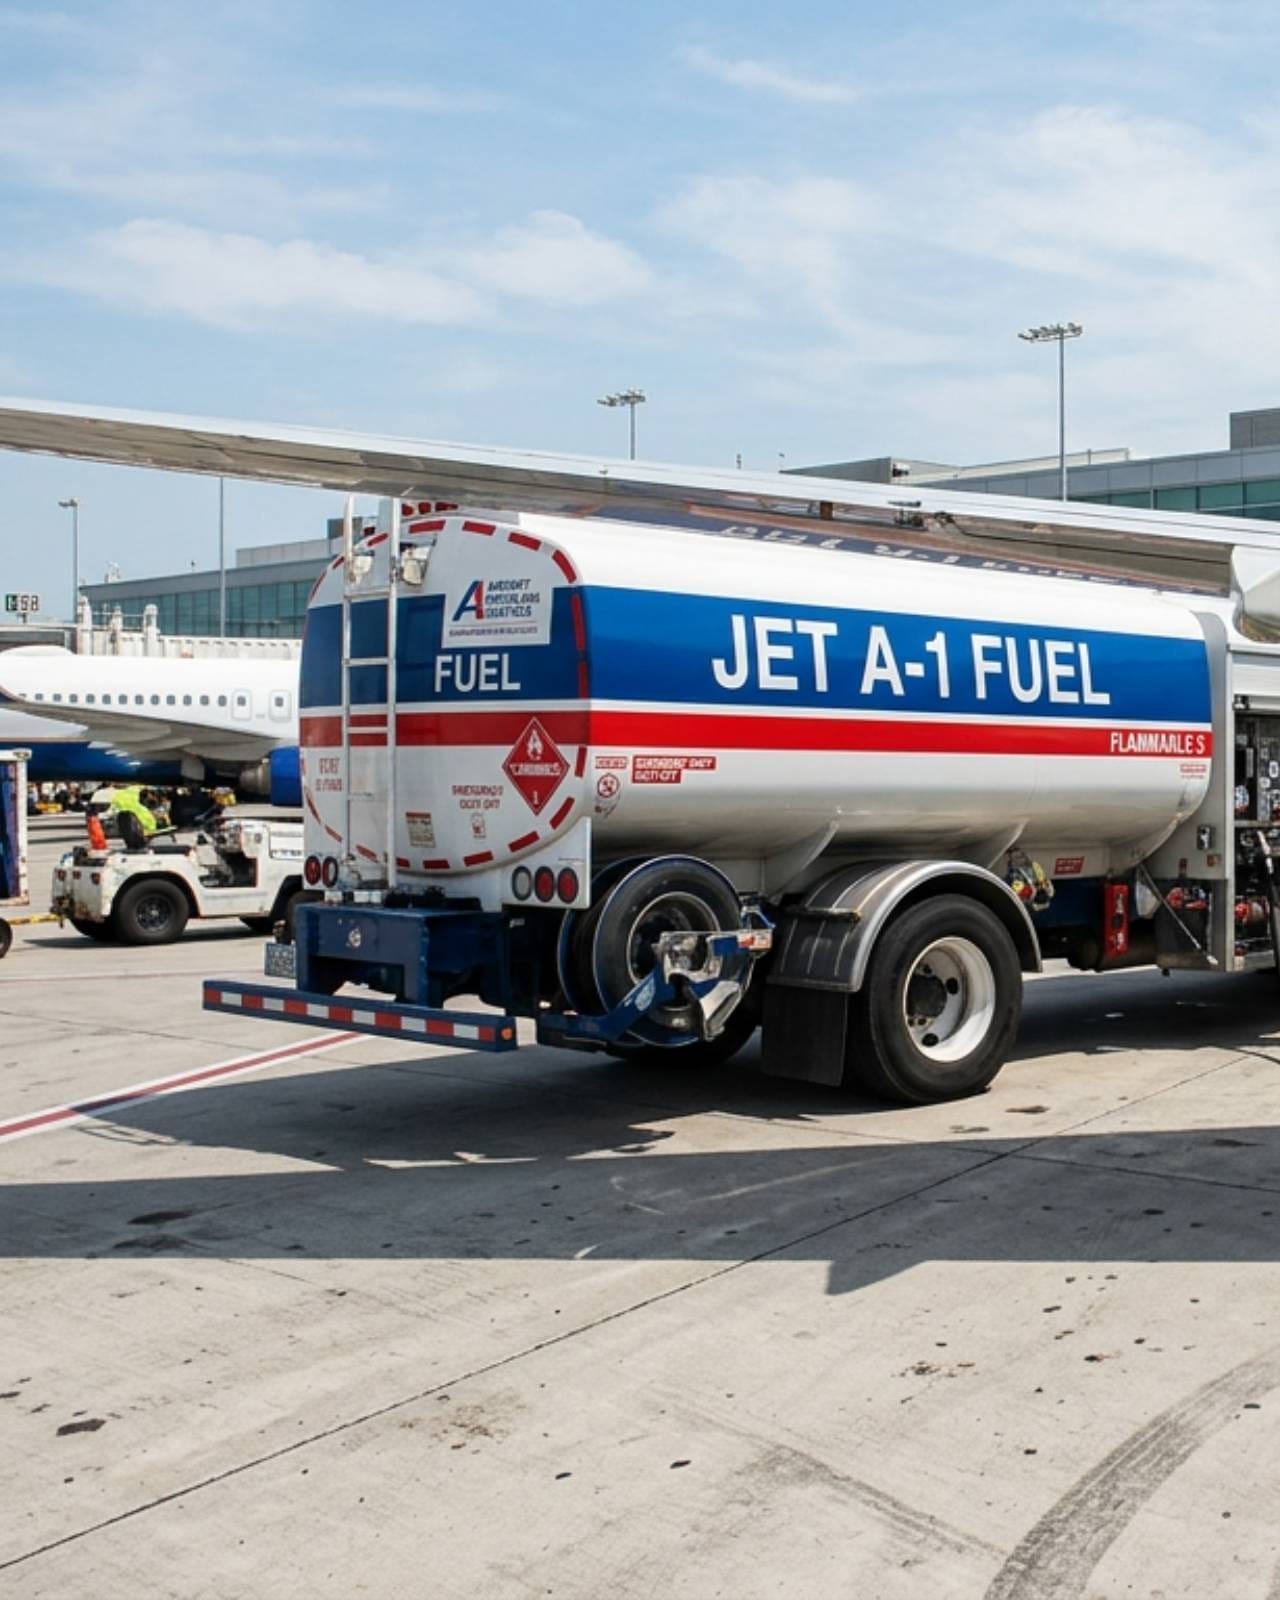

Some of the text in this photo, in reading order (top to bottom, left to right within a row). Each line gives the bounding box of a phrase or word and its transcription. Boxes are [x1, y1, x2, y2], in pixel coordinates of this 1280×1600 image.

[434, 653, 521, 693] FUEL
[711, 614, 1111, 706] JET A-1 FUEL
